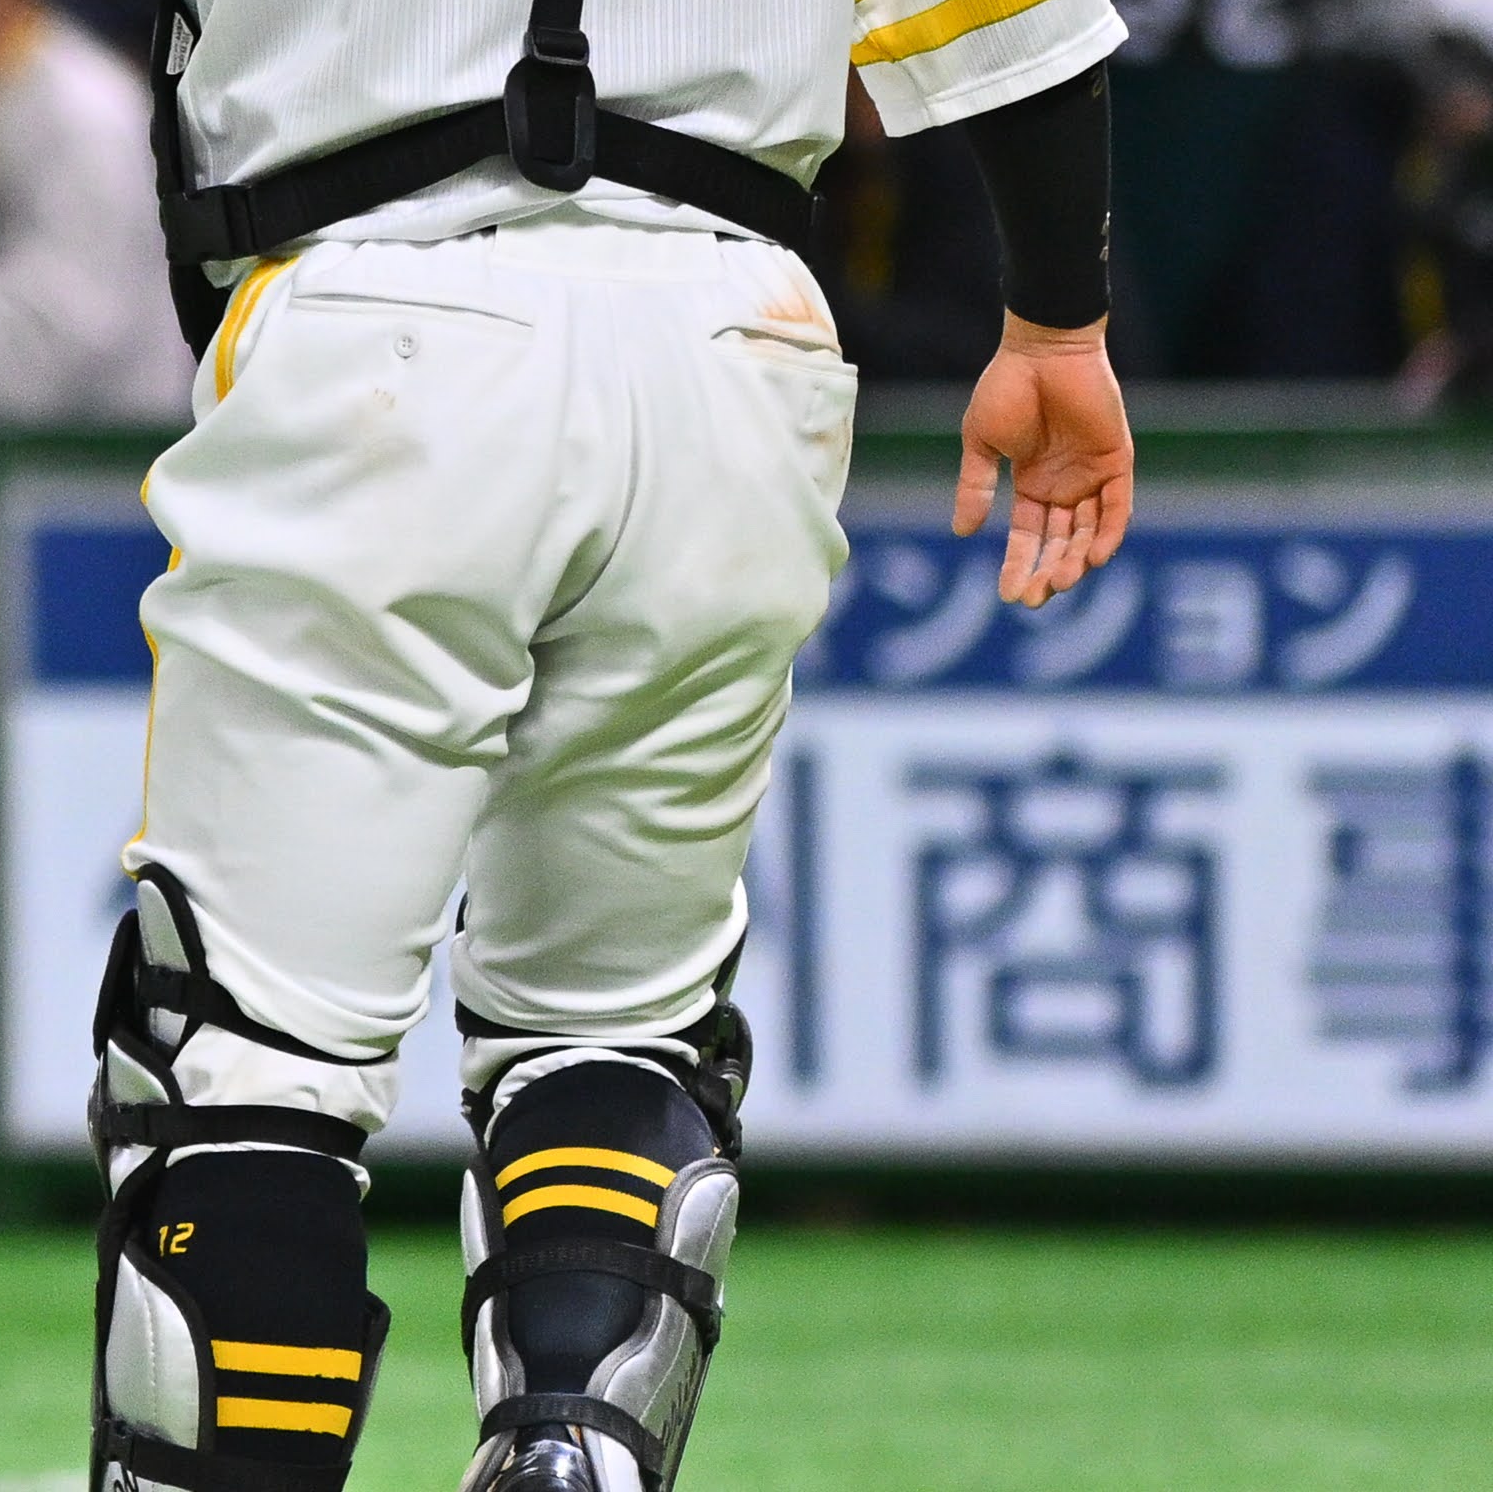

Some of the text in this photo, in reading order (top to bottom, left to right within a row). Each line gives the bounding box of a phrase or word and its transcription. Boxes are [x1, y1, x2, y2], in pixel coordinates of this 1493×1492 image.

[813, 540, 1415, 690] ンション
[783, 738, 1493, 1093] 商事
[158, 1222, 196, 1257] 12
